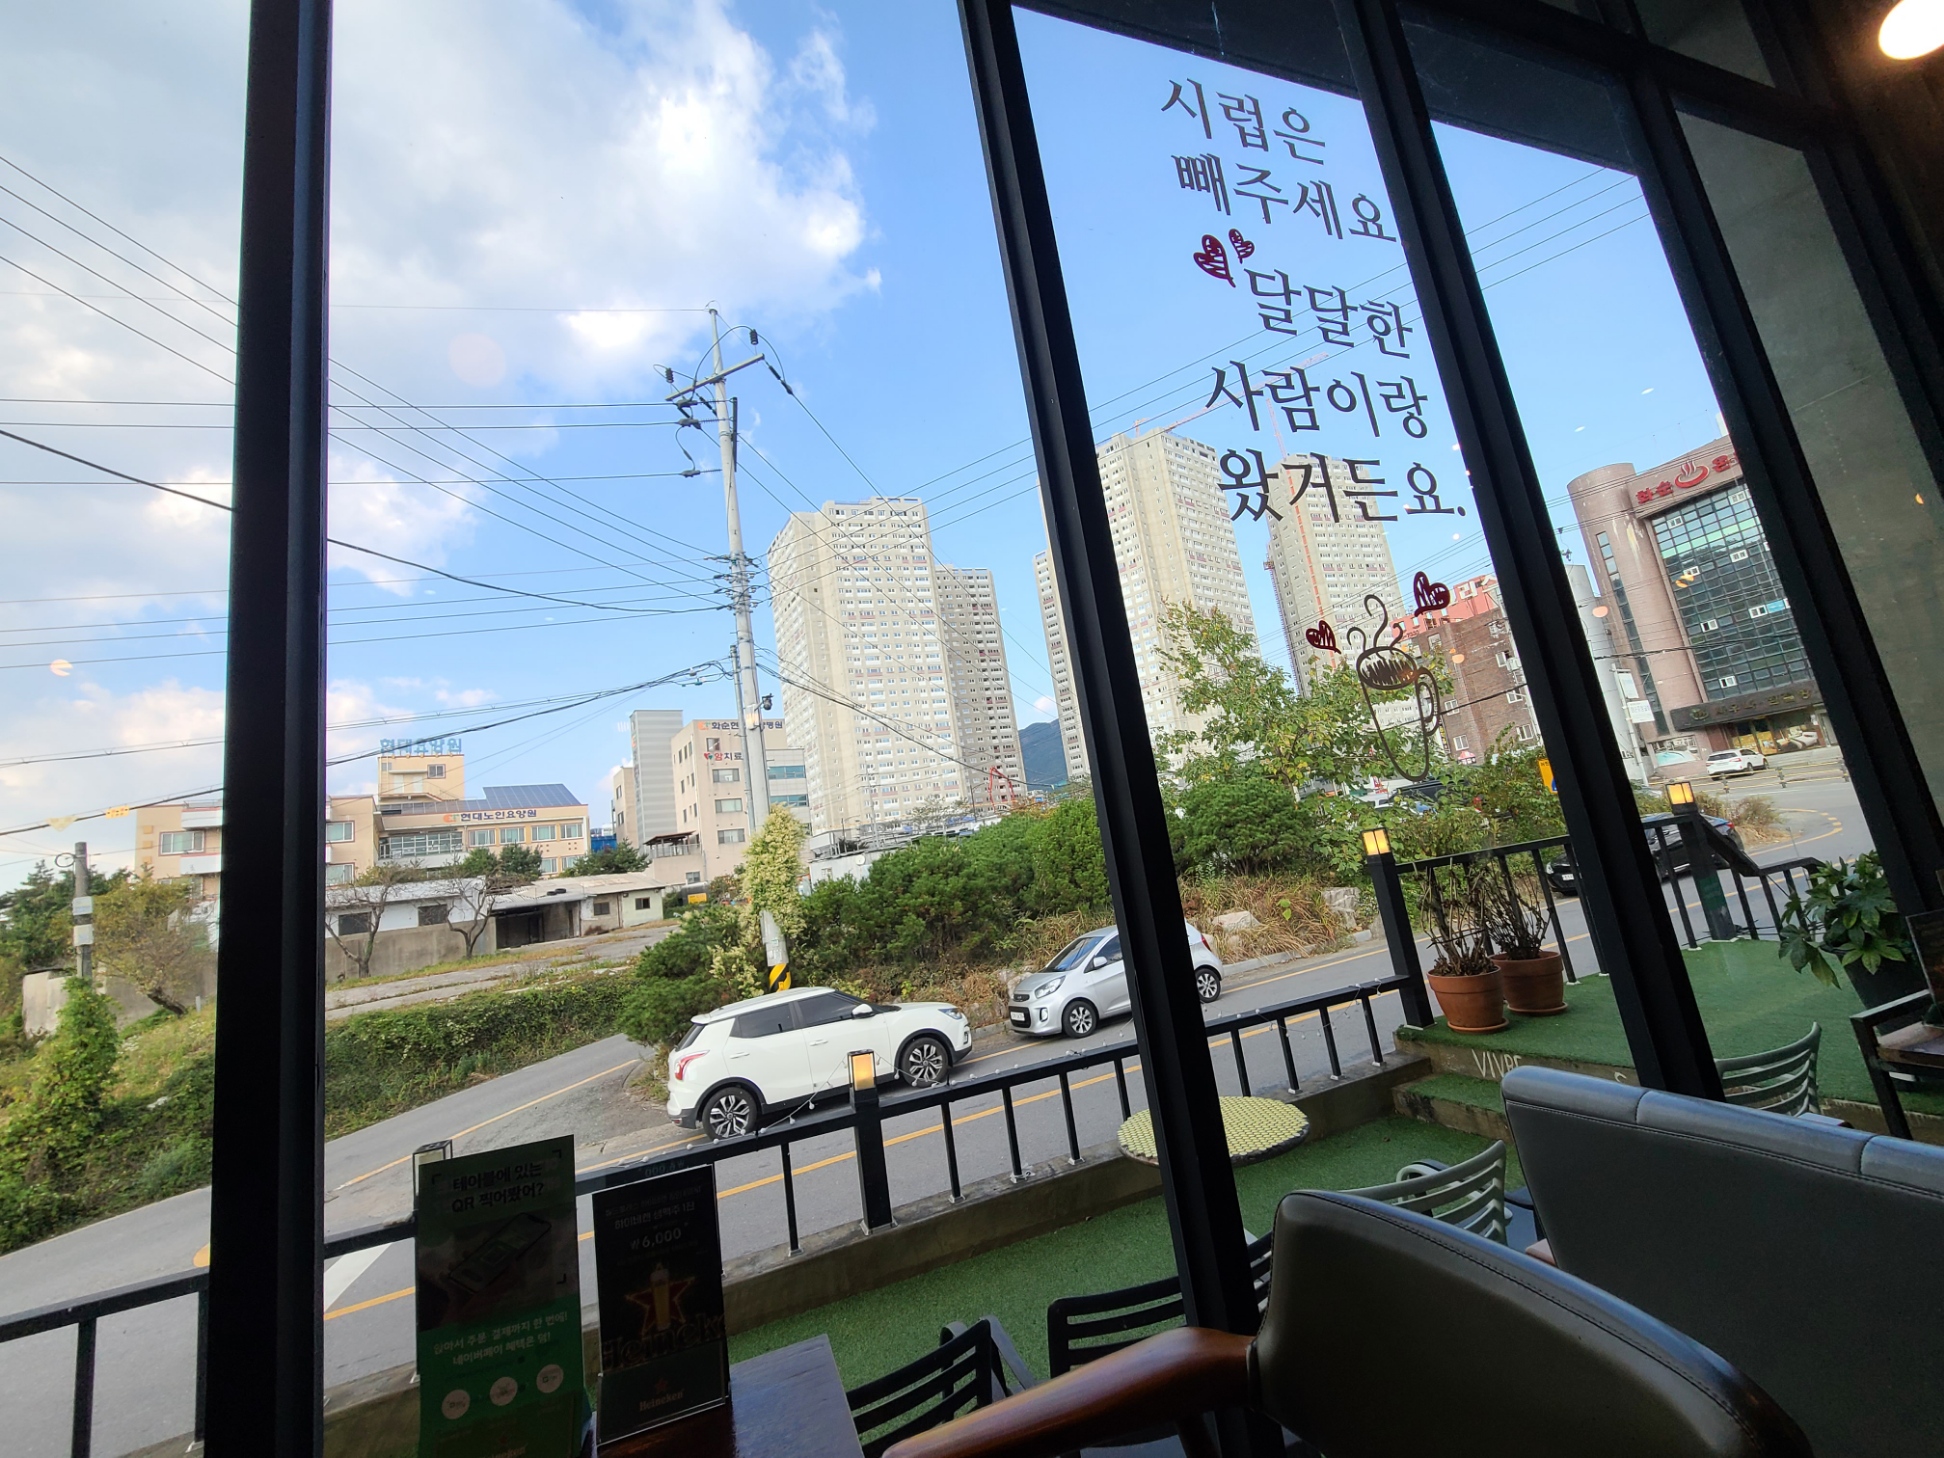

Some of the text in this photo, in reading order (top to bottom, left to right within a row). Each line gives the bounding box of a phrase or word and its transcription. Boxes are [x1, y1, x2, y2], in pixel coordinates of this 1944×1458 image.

[1161, 78, 1326, 165] 시럽은
[1171, 153, 1397, 242] 빼주세요
[1244, 268, 1413, 359] 달달한
[1205, 360, 1429, 439] 사람이랑
[1712, 452, 1738, 473] 온
[1216, 447, 1467, 524] 왔거든요.
[461, 809, 537, 822] 현대노인요양원
[453, 1162, 543, 1191] 테이블에 있는
[452, 1183, 544, 1212] QR 찍어봤어?
[452, 1345, 503, 1365] 네이버페이
[639, 1388, 685, 1412] Heineken
